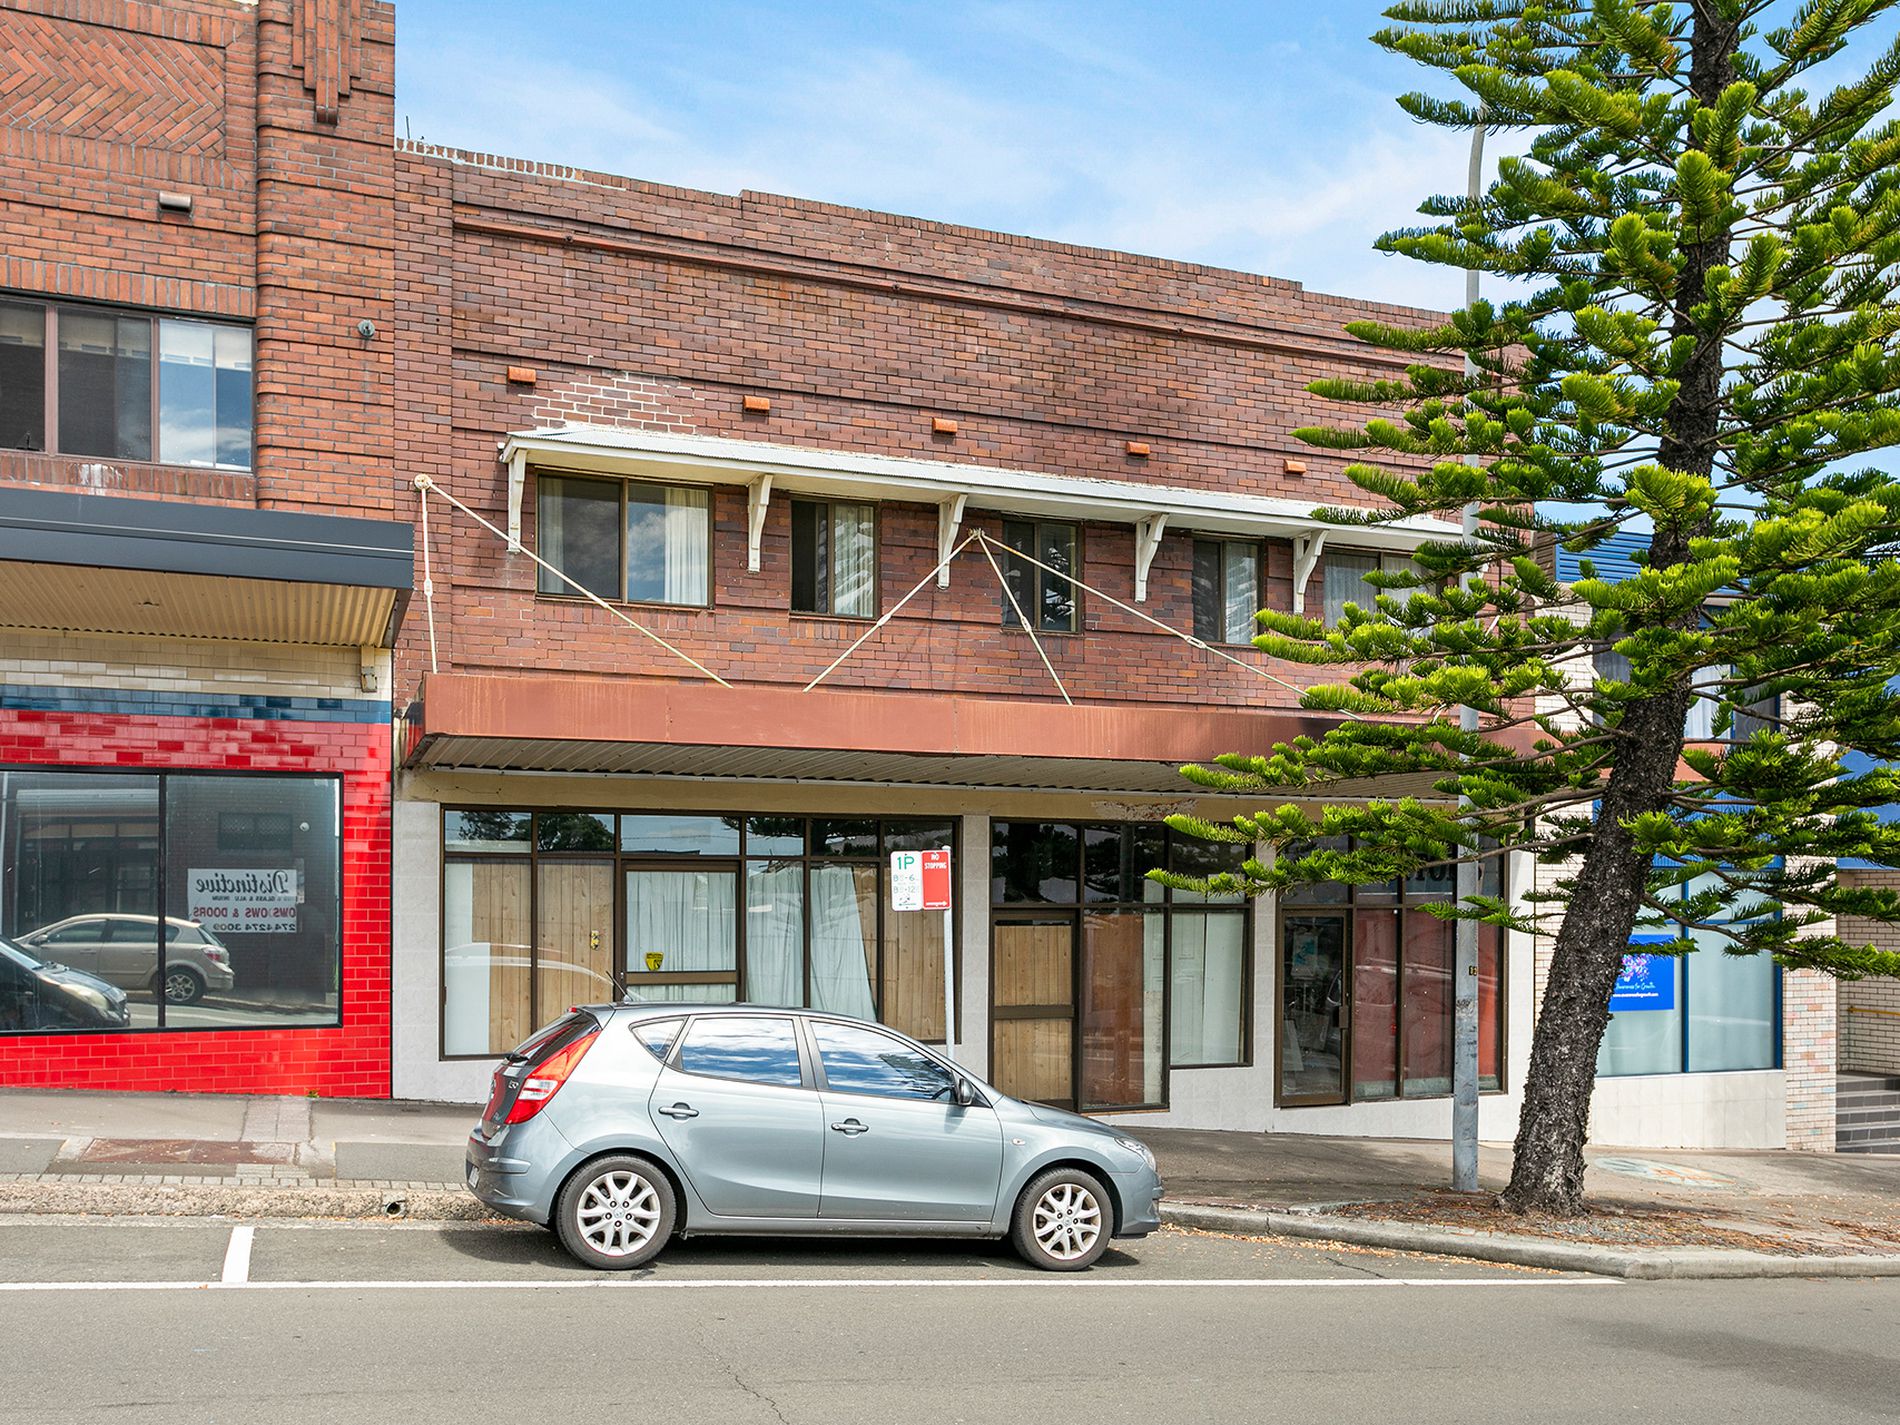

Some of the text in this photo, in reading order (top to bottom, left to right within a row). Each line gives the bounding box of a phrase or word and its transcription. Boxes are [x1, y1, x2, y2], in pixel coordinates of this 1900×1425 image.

[930, 853, 940, 861] NO
[897, 856, 915, 870] 1P
[924, 862, 947, 870] STOPPING
